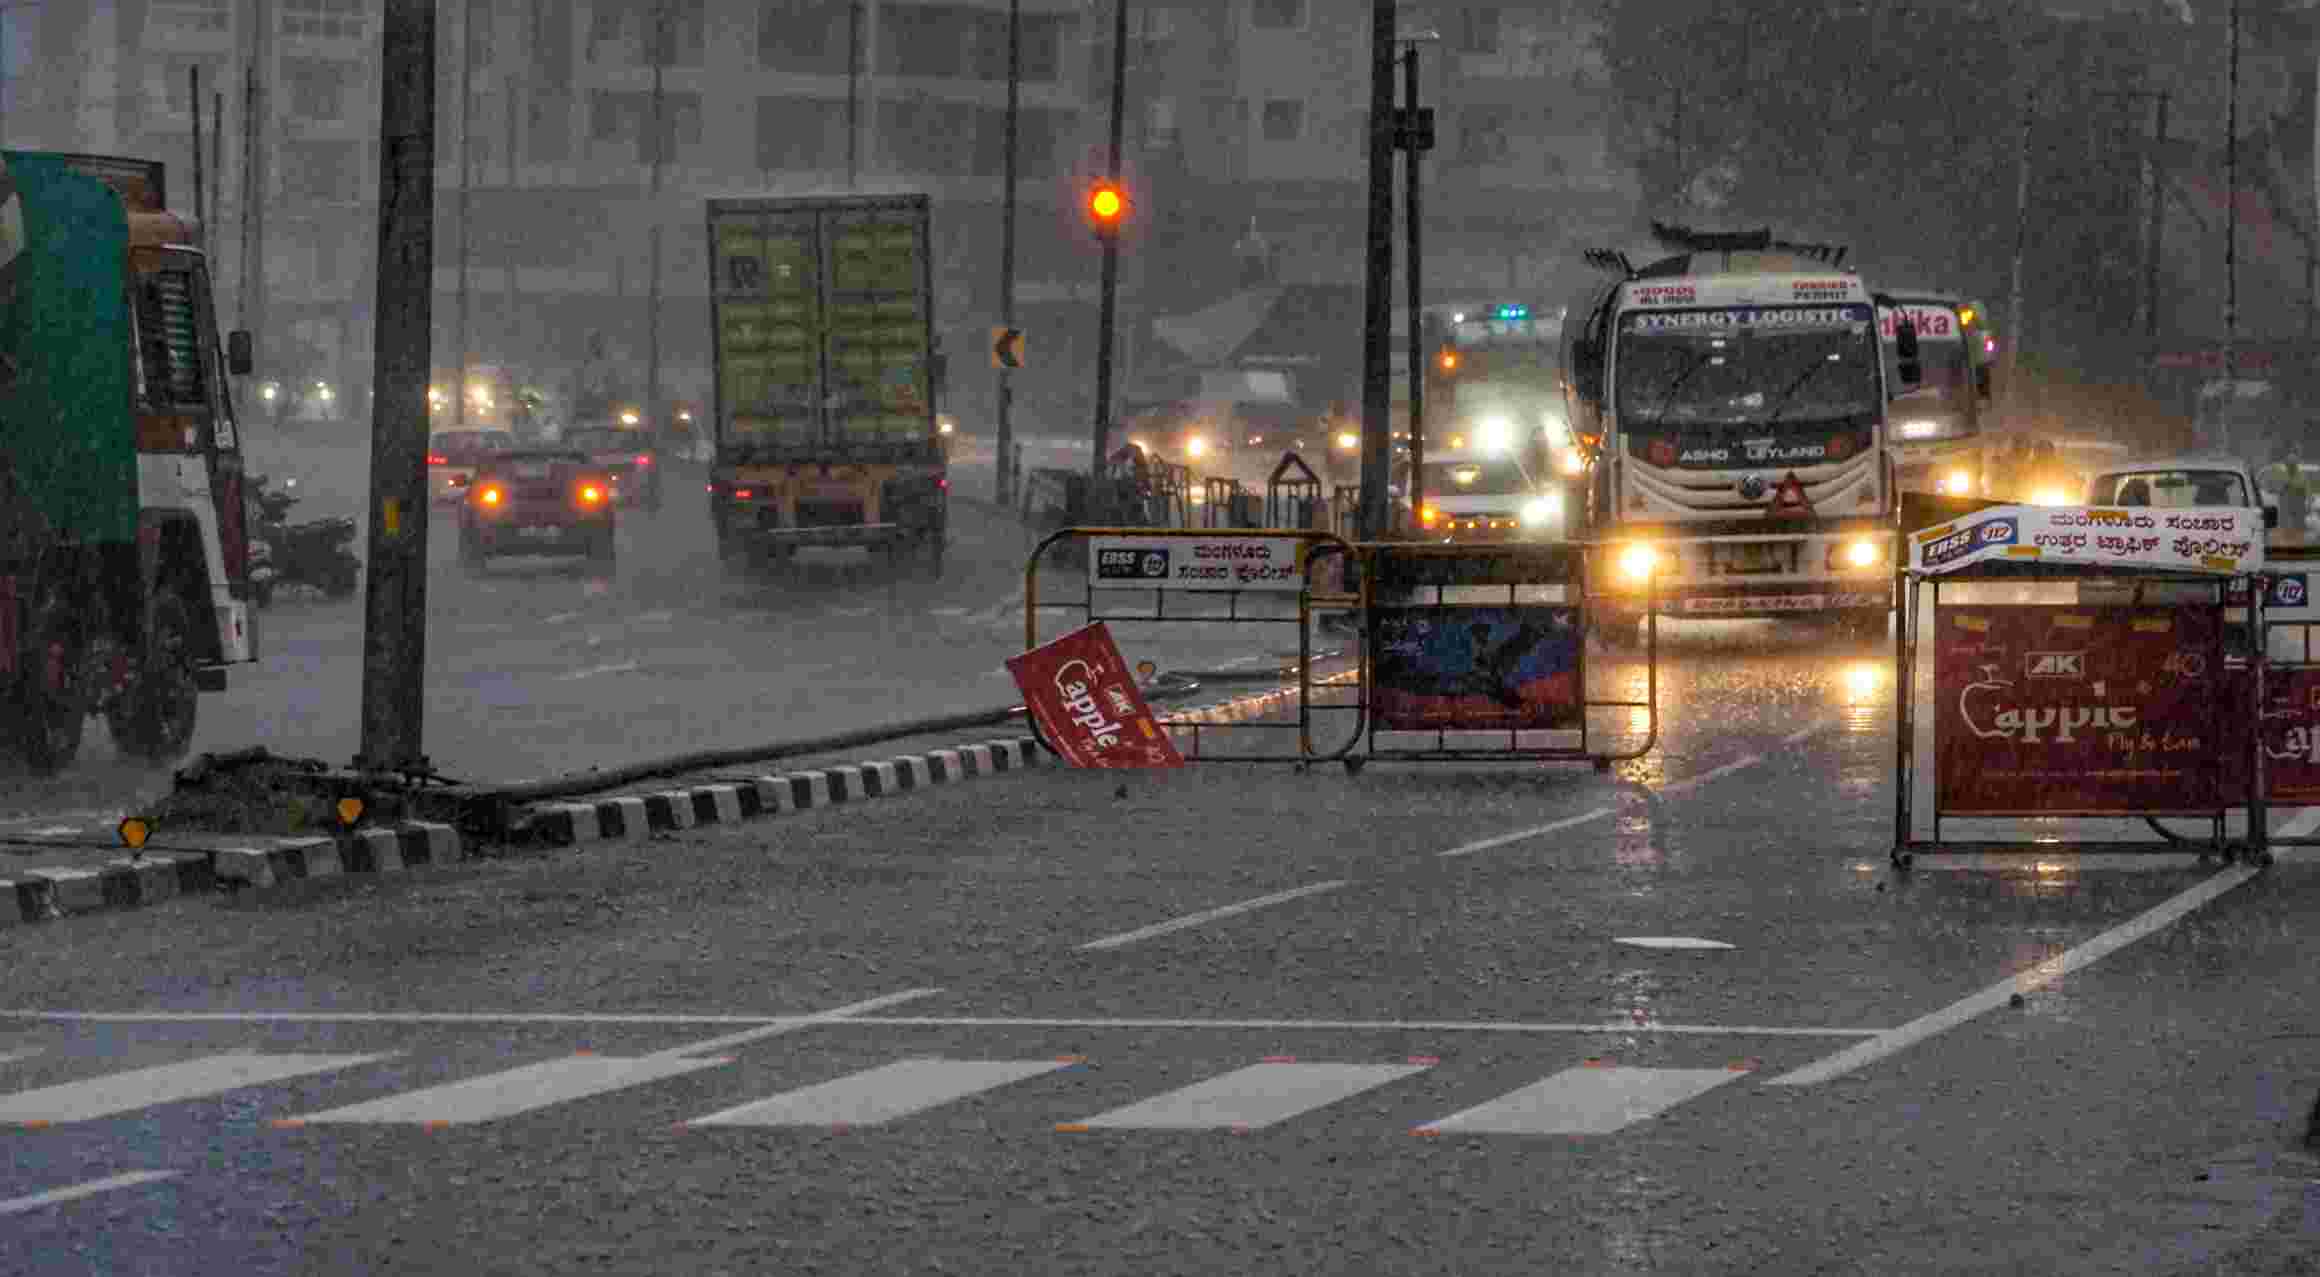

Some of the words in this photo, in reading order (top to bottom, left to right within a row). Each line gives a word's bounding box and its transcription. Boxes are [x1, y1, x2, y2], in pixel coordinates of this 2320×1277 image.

[1636, 310, 1738, 328] SYNERGY
[1748, 307, 1854, 325] LOGISTIC
[1746, 447, 1825, 460] LEYLAND
[2031, 654, 2081, 675] AK
